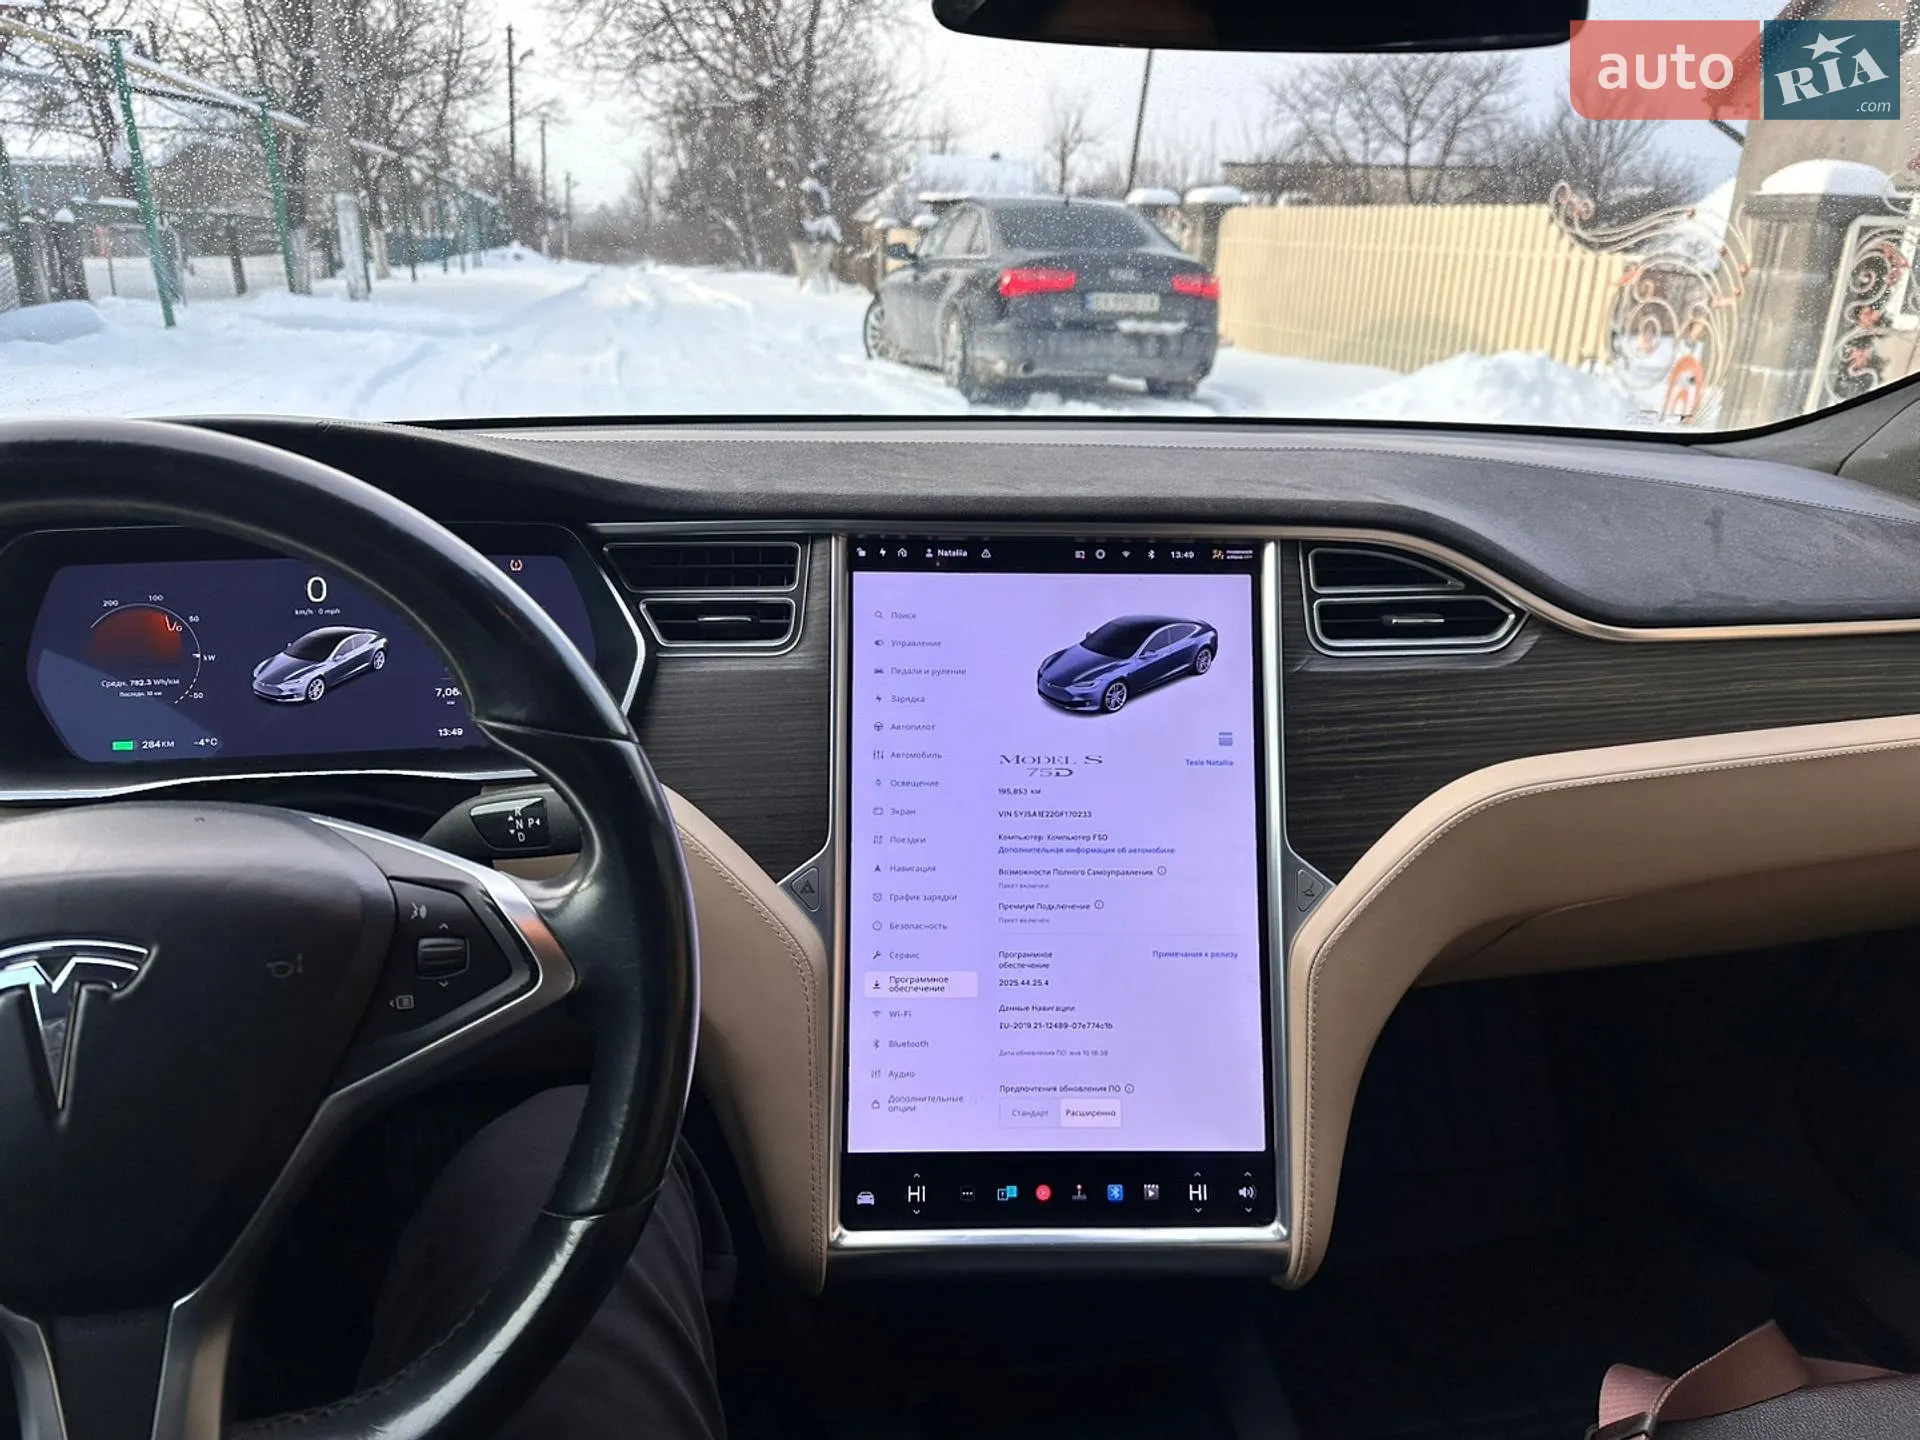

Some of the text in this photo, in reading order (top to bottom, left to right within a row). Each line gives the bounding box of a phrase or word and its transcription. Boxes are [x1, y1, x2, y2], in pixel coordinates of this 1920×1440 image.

[1170, 550, 1195, 559] 13:49
[307, 576, 327, 603] 0
[148, 594, 164, 602] 100
[103, 599, 119, 608] 200
[890, 610, 917, 620] Поиск
[890, 638, 942, 649] Управление
[890, 666, 922, 676] Педали
[931, 668, 967, 678] руление
[890, 695, 926, 704] Зарядка
[437, 727, 464, 737] 13:49
[889, 723, 936, 731] Автопилот
[889, 751, 943, 760] Автомобиль
[1000, 754, 1104, 765] MODEL S
[889, 779, 940, 789] Освещение
[889, 807, 917, 817] Экран
[998, 810, 1012, 818] VIN
[515, 818, 535, 829] N P
[517, 832, 526, 842] D
[889, 835, 927, 845] Поездки
[1046, 833, 1092, 842] Компьютер
[998, 846, 1064, 855] Дополнительная
[1065, 846, 1116, 855] информация
[1128, 846, 1176, 855] автомобиле
[889, 864, 937, 873] Навигация
[998, 868, 1154, 877] Возможности Полного Самоуправления
[889, 893, 958, 903] График зарядки
[998, 901, 1092, 912] Премиум Подключение
[889, 921, 948, 931] Безопасность
[889, 951, 921, 961] Сервис
[998, 950, 1054, 960] Программное
[1151, 949, 1203, 960] Примечания
[1210, 950, 1239, 960] релизу
[998, 961, 1051, 970] обеспечение
[889, 975, 950, 985] Программное
[888, 985, 946, 994] обеспечение
[998, 1004, 1076, 1013] Данные Навигации
[888, 1009, 913, 1019] Wi-Fi
[888, 1039, 930, 1049] Bluetooth
[888, 1069, 917, 1080] Аудио
[999, 1083, 1121, 1094] Предпочтения обновления ПО
[888, 1093, 964, 1105] Дополнительные
[888, 1104, 917, 1114] опции
[1011, 1108, 1050, 1119] Стандарт
[1064, 1108, 1116, 1118] Расширенно
[907, 1184, 926, 1203] HI
[1188, 1183, 1208, 1202] HI
